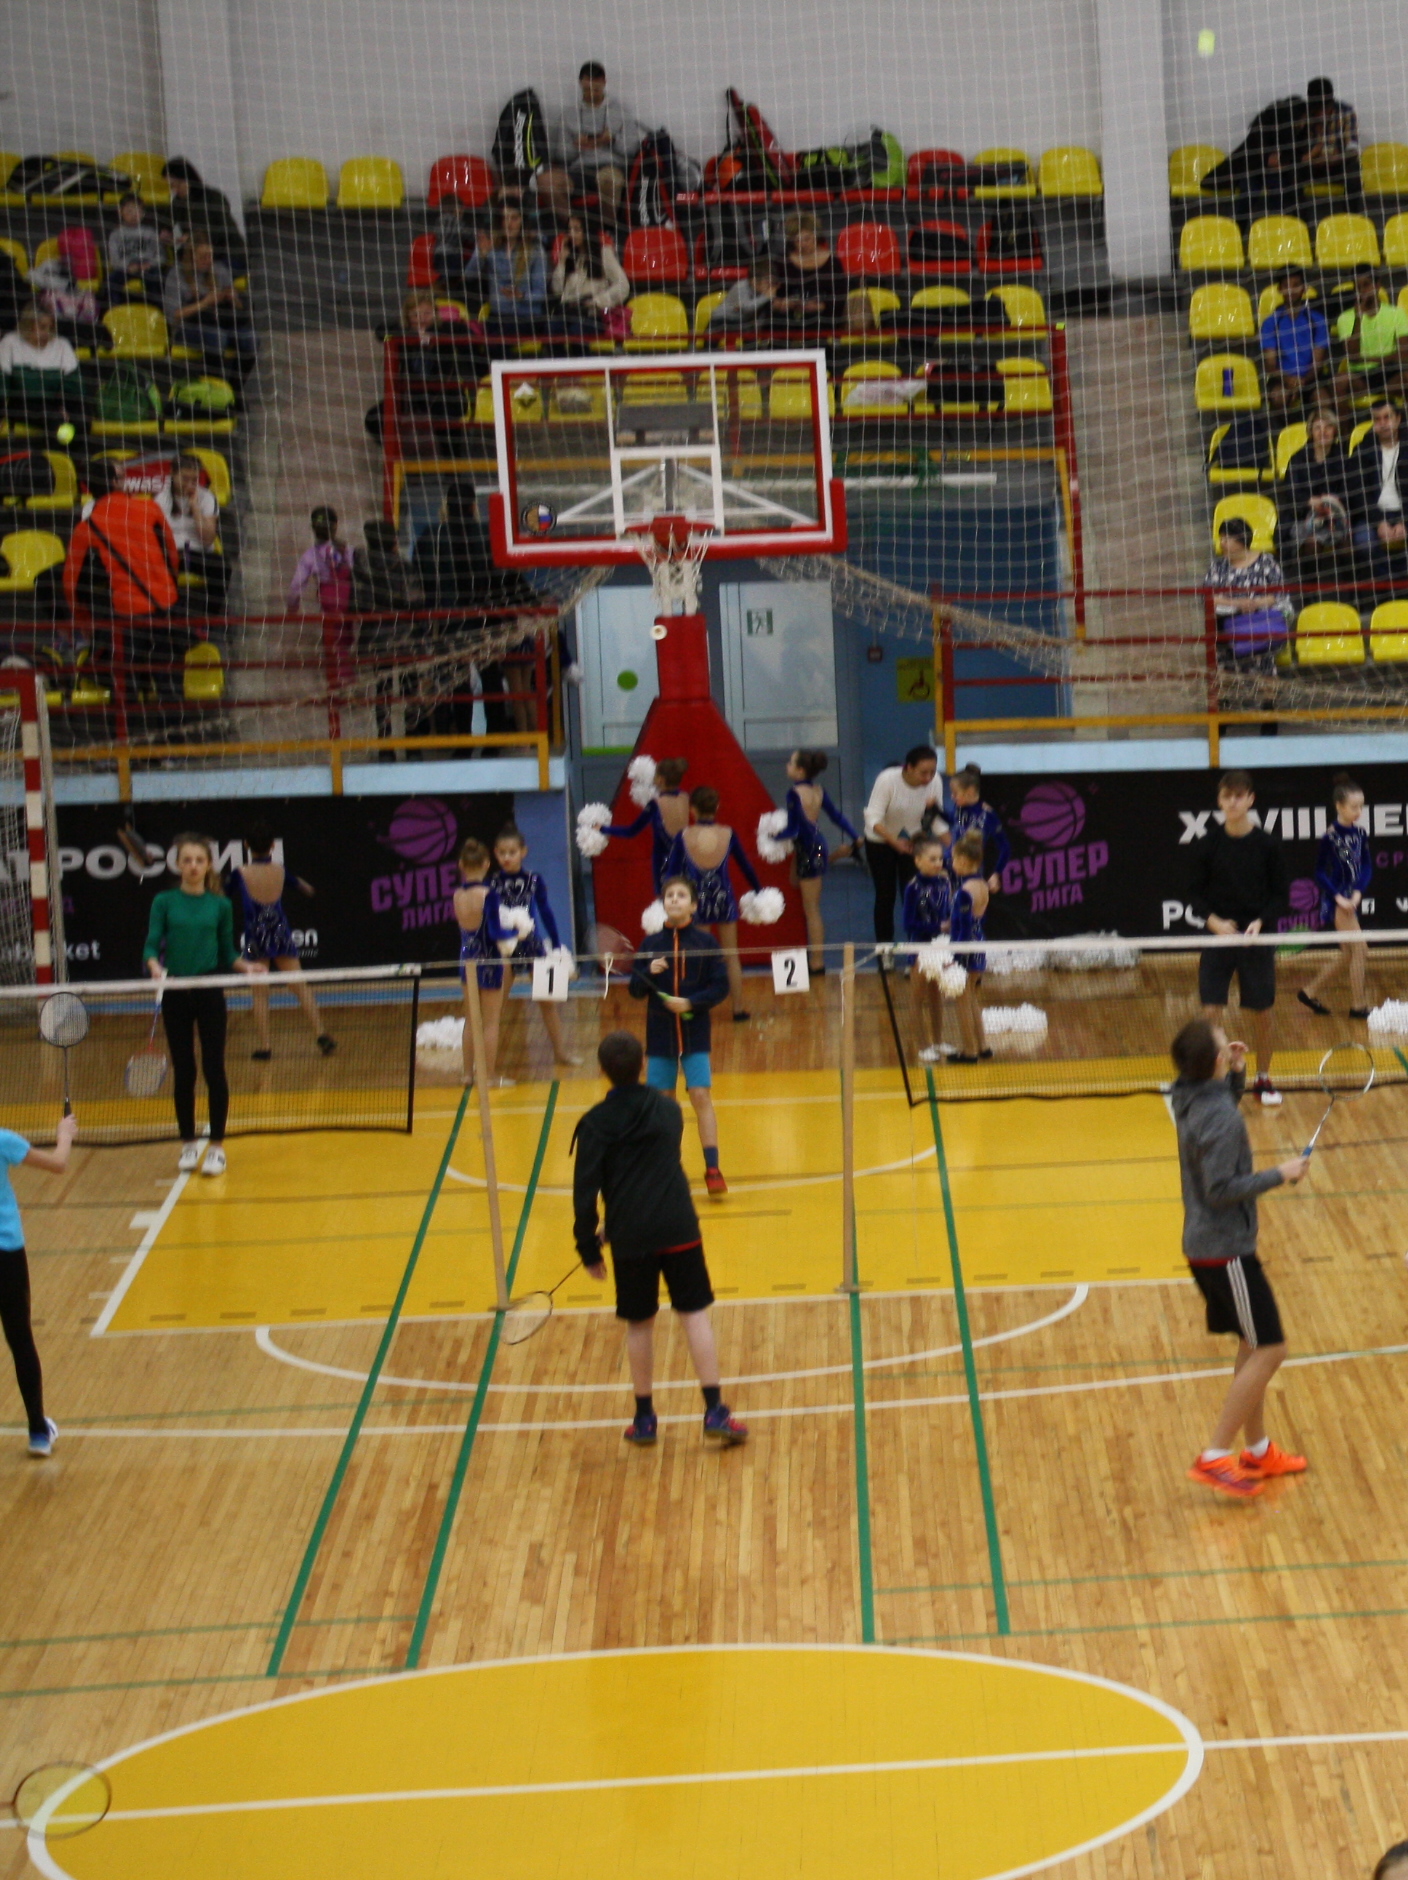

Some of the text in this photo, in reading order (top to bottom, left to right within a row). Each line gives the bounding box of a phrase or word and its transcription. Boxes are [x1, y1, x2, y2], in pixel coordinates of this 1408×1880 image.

[371, 861, 461, 912] СУПЕ
[1003, 840, 1109, 896] СУПЕР
[1031, 882, 1085, 914] ЛИГА
[784, 958, 797, 989] 2
